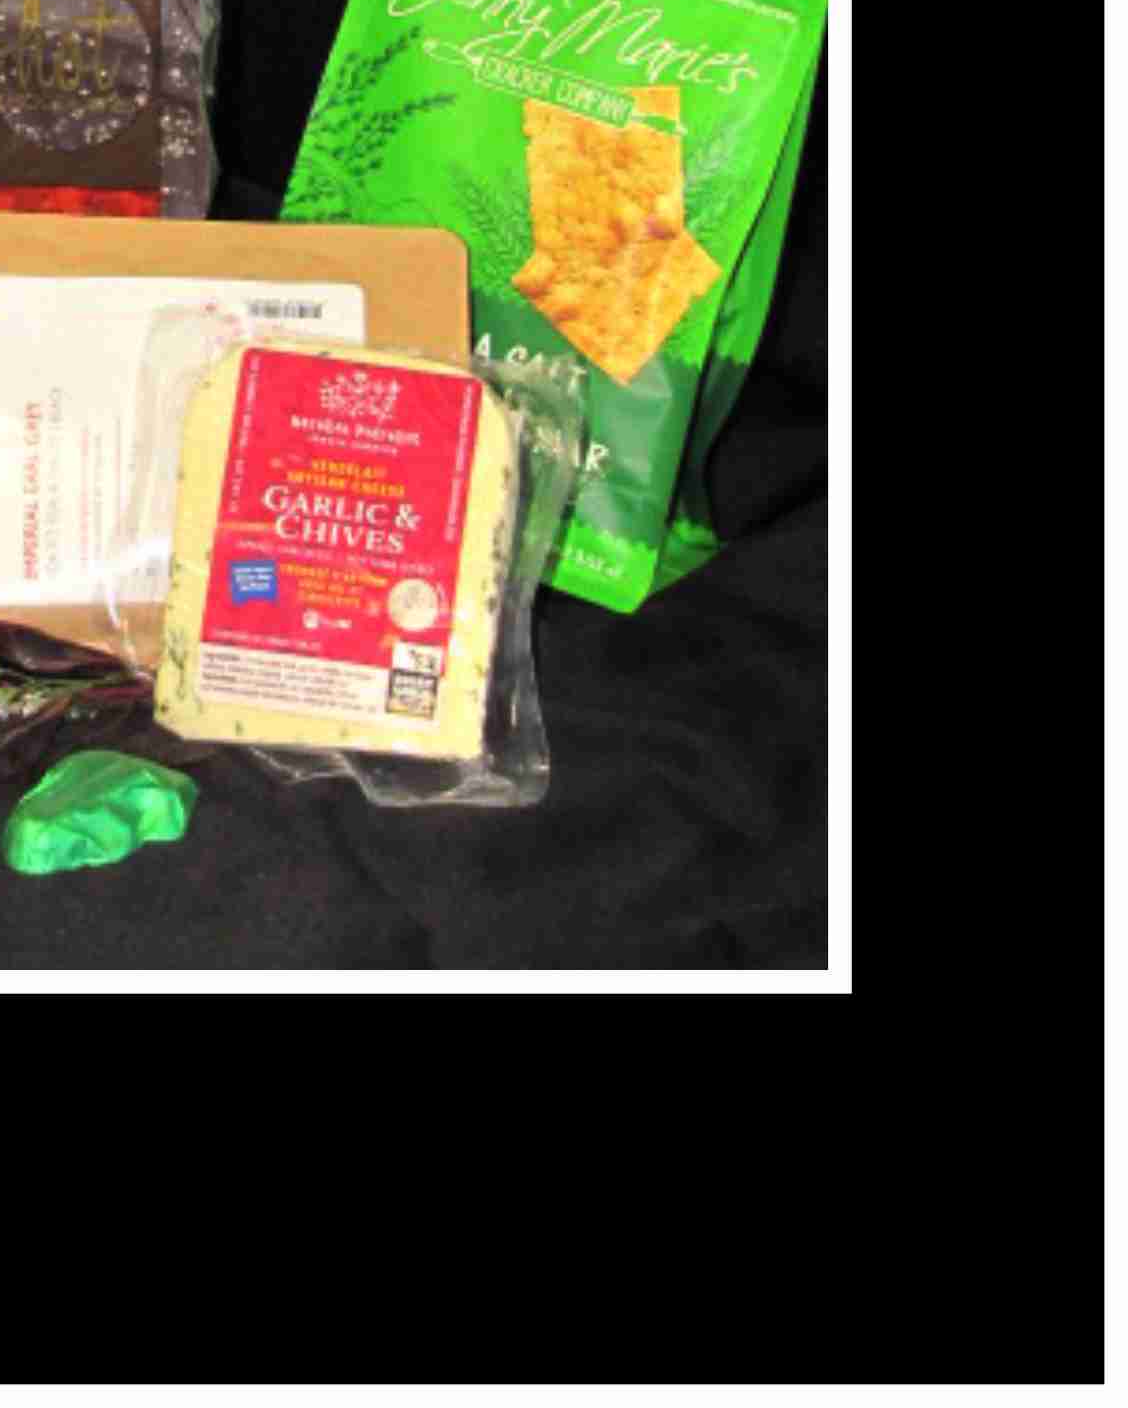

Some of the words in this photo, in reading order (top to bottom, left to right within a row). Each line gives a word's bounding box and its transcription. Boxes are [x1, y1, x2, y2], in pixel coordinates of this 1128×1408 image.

[261, 484, 390, 526] GARLIC
[394, 502, 422, 531] &
[274, 511, 405, 555] CHIVES
